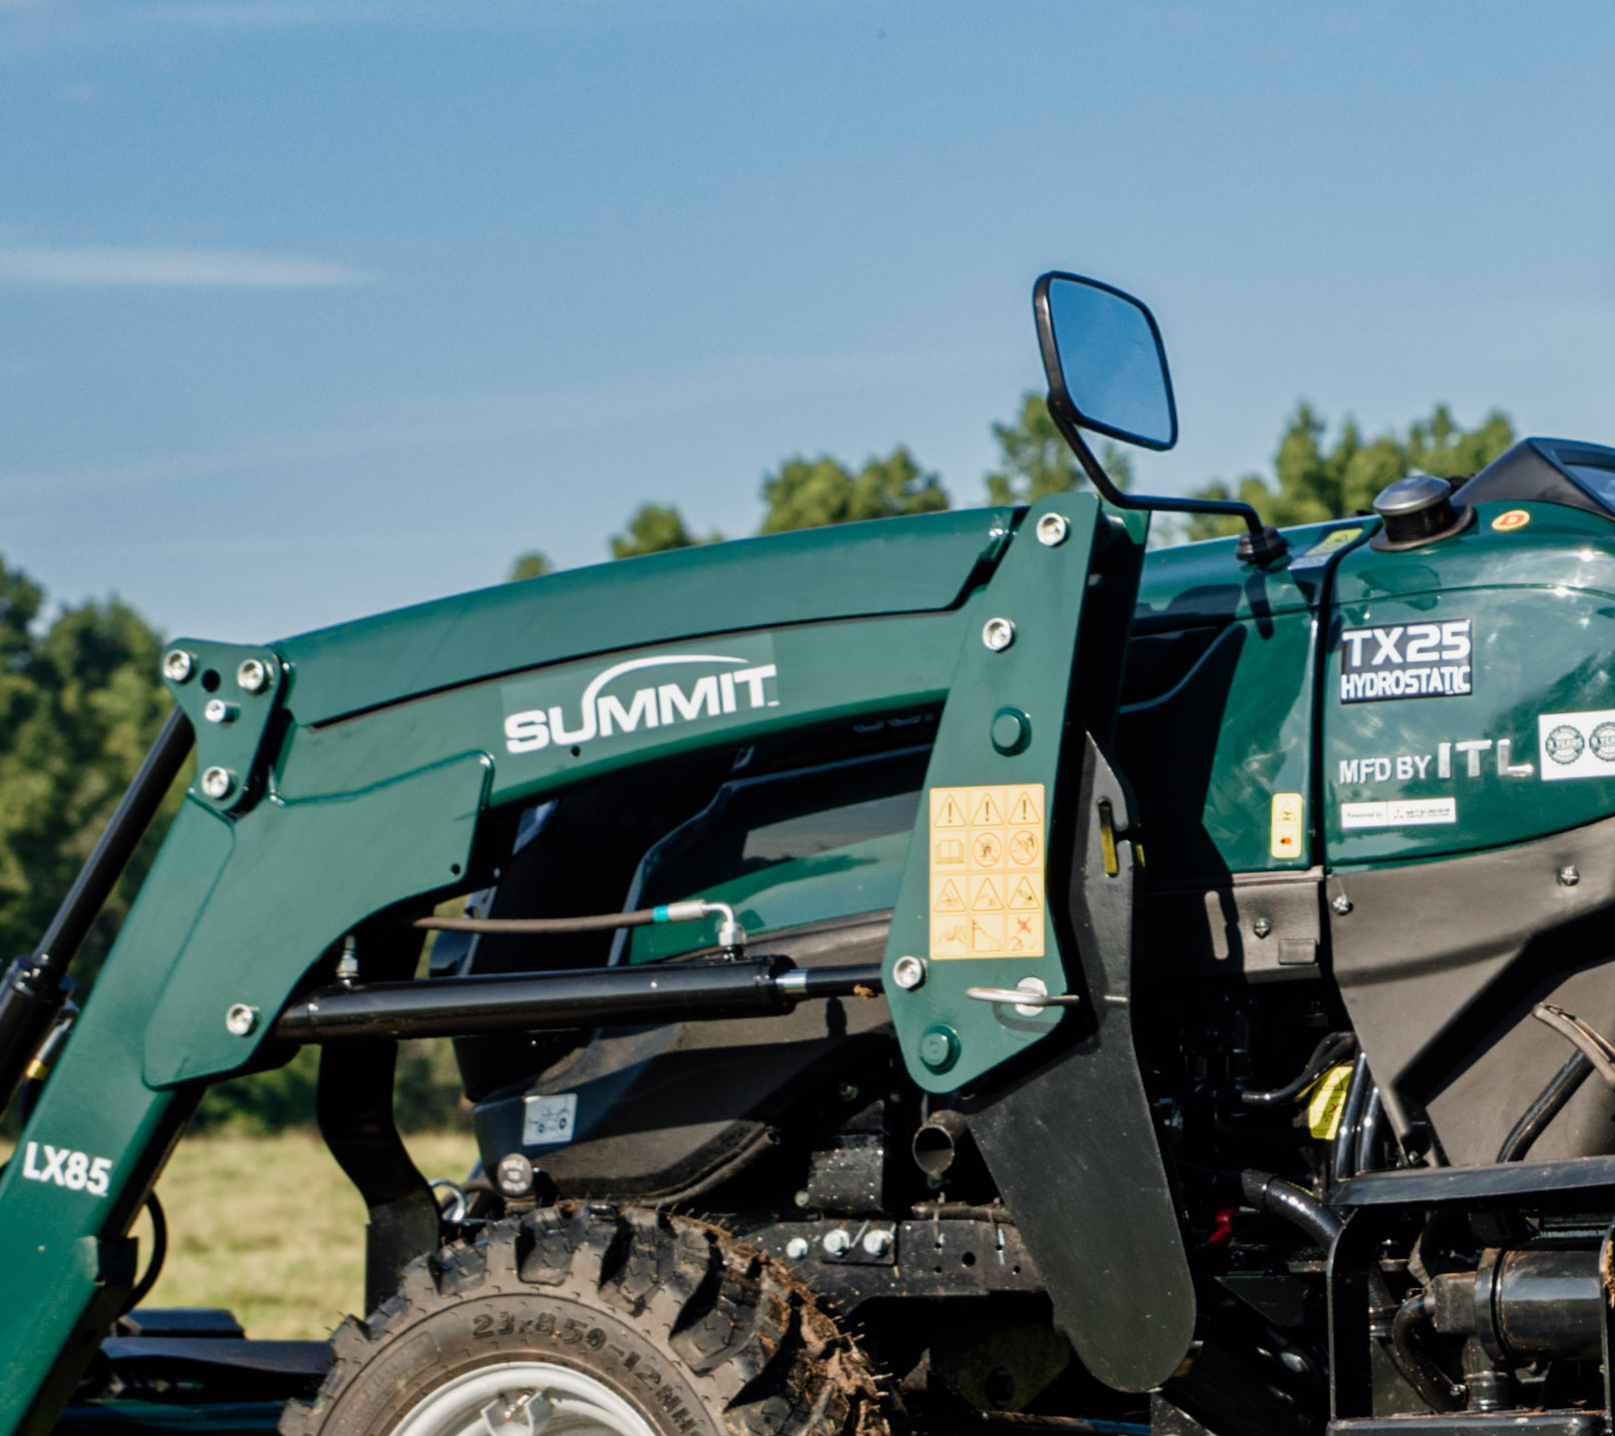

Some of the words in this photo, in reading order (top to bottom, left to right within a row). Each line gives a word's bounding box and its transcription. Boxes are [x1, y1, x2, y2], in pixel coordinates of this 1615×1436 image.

[1342, 622, 1471, 668] TX25
[504, 654, 778, 754] SUMMIT
[1341, 665, 1471, 701] HYDROSTATIC
[1340, 758, 1391, 784] MFD
[1396, 755, 1432, 780] BY
[1438, 738, 1534, 778] ITL
[23, 1141, 112, 1198] LX85
